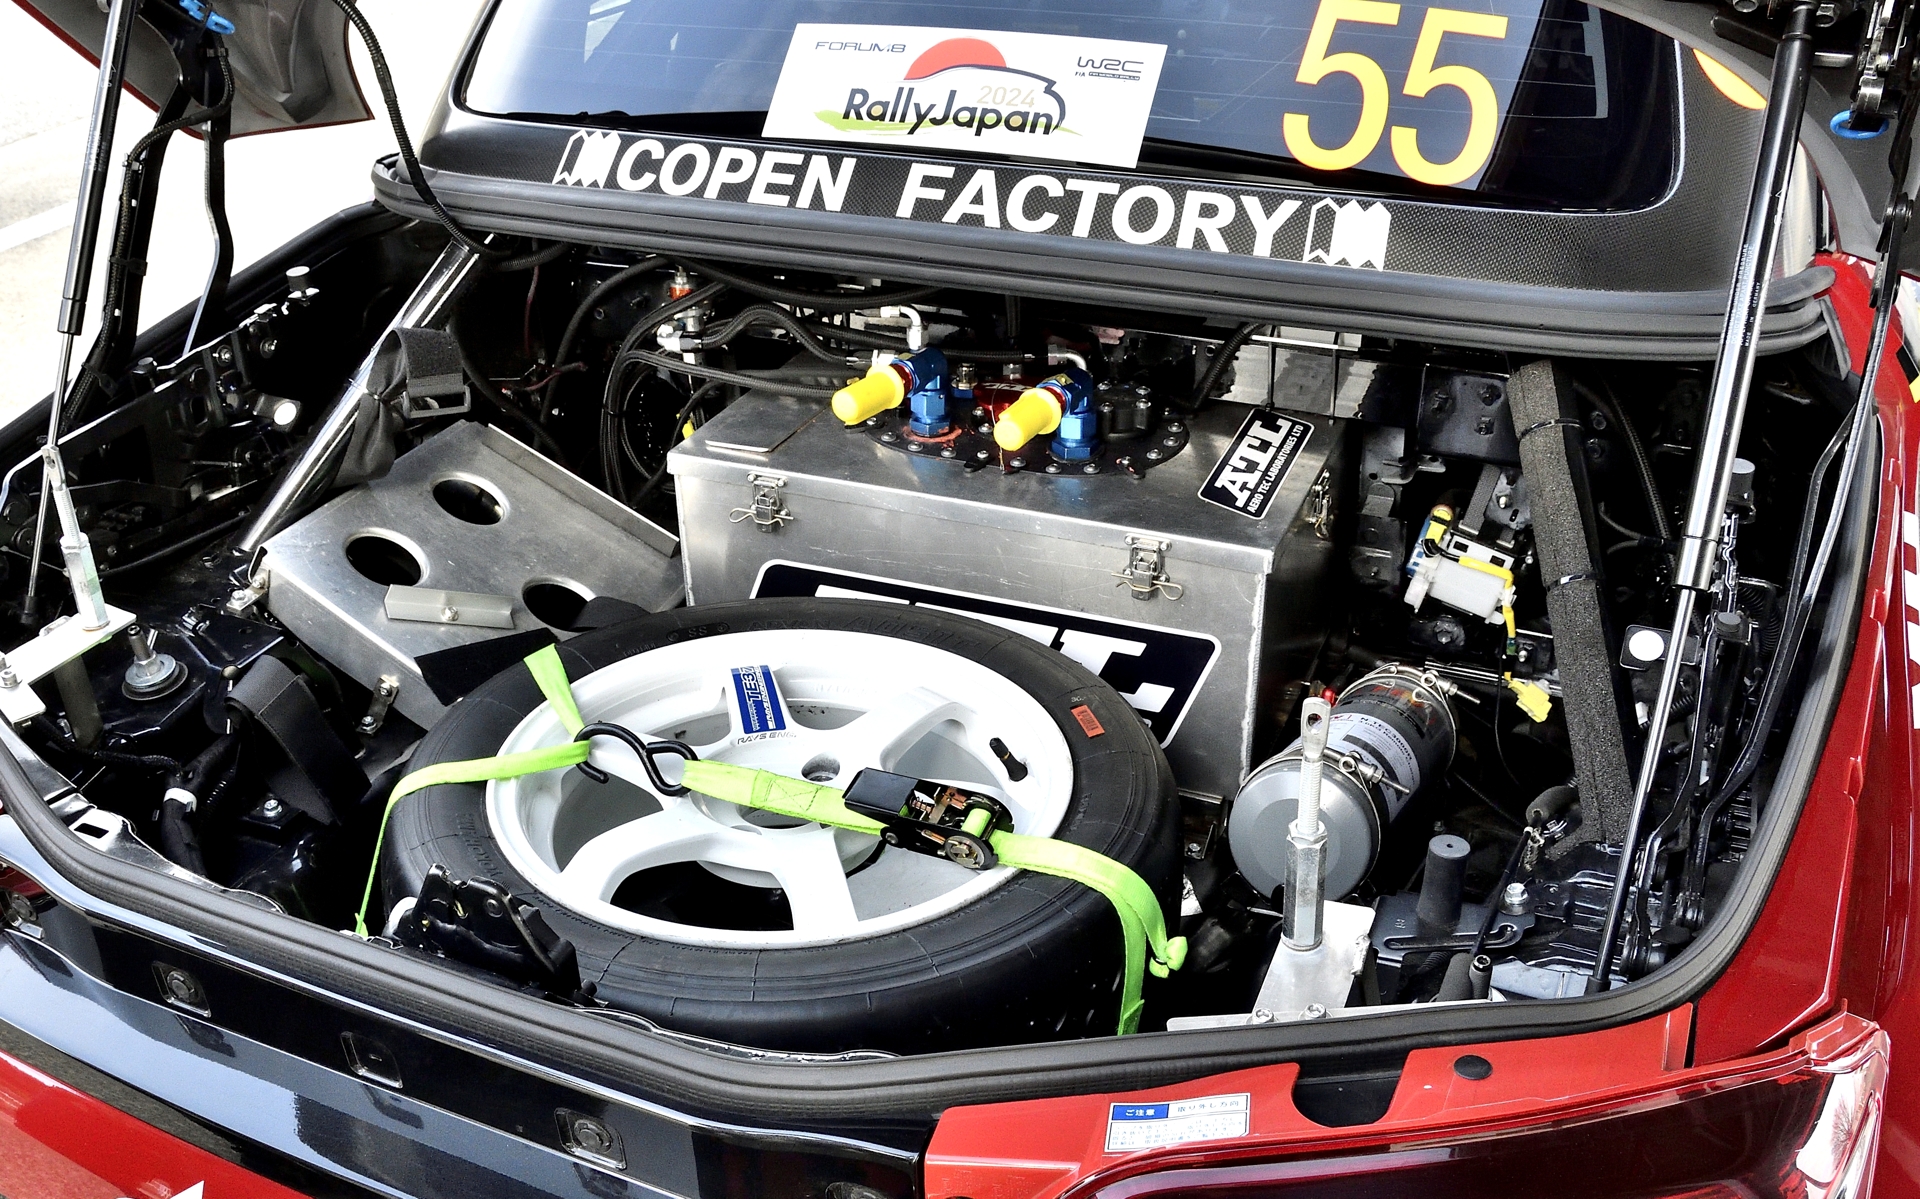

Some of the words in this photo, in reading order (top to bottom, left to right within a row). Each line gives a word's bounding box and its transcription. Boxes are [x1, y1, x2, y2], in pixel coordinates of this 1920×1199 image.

[815, 41, 906, 53] FORUM8
[1077, 56, 1144, 73] WRC
[977, 85, 1035, 108] 2024
[1282, 0, 1508, 186] 55
[616, 139, 856, 212] COPEN
[896, 162, 1302, 257] FACTORY
[1733, 282, 1741, 304] UNDER
[1737, 242, 1748, 278] PRESSURE
[1752, 281, 1760, 307] GERMANY
[1214, 418, 1293, 508] ATL
[1246, 491, 1262, 513] AERO
[1261, 480, 1272, 494] TEC
[1267, 436, 1298, 482] LABORATORIES
[1291, 425, 1304, 439] LTD
[738, 664, 761, 702] TE37
[1125, 1108, 1156, 1117] ご注意
